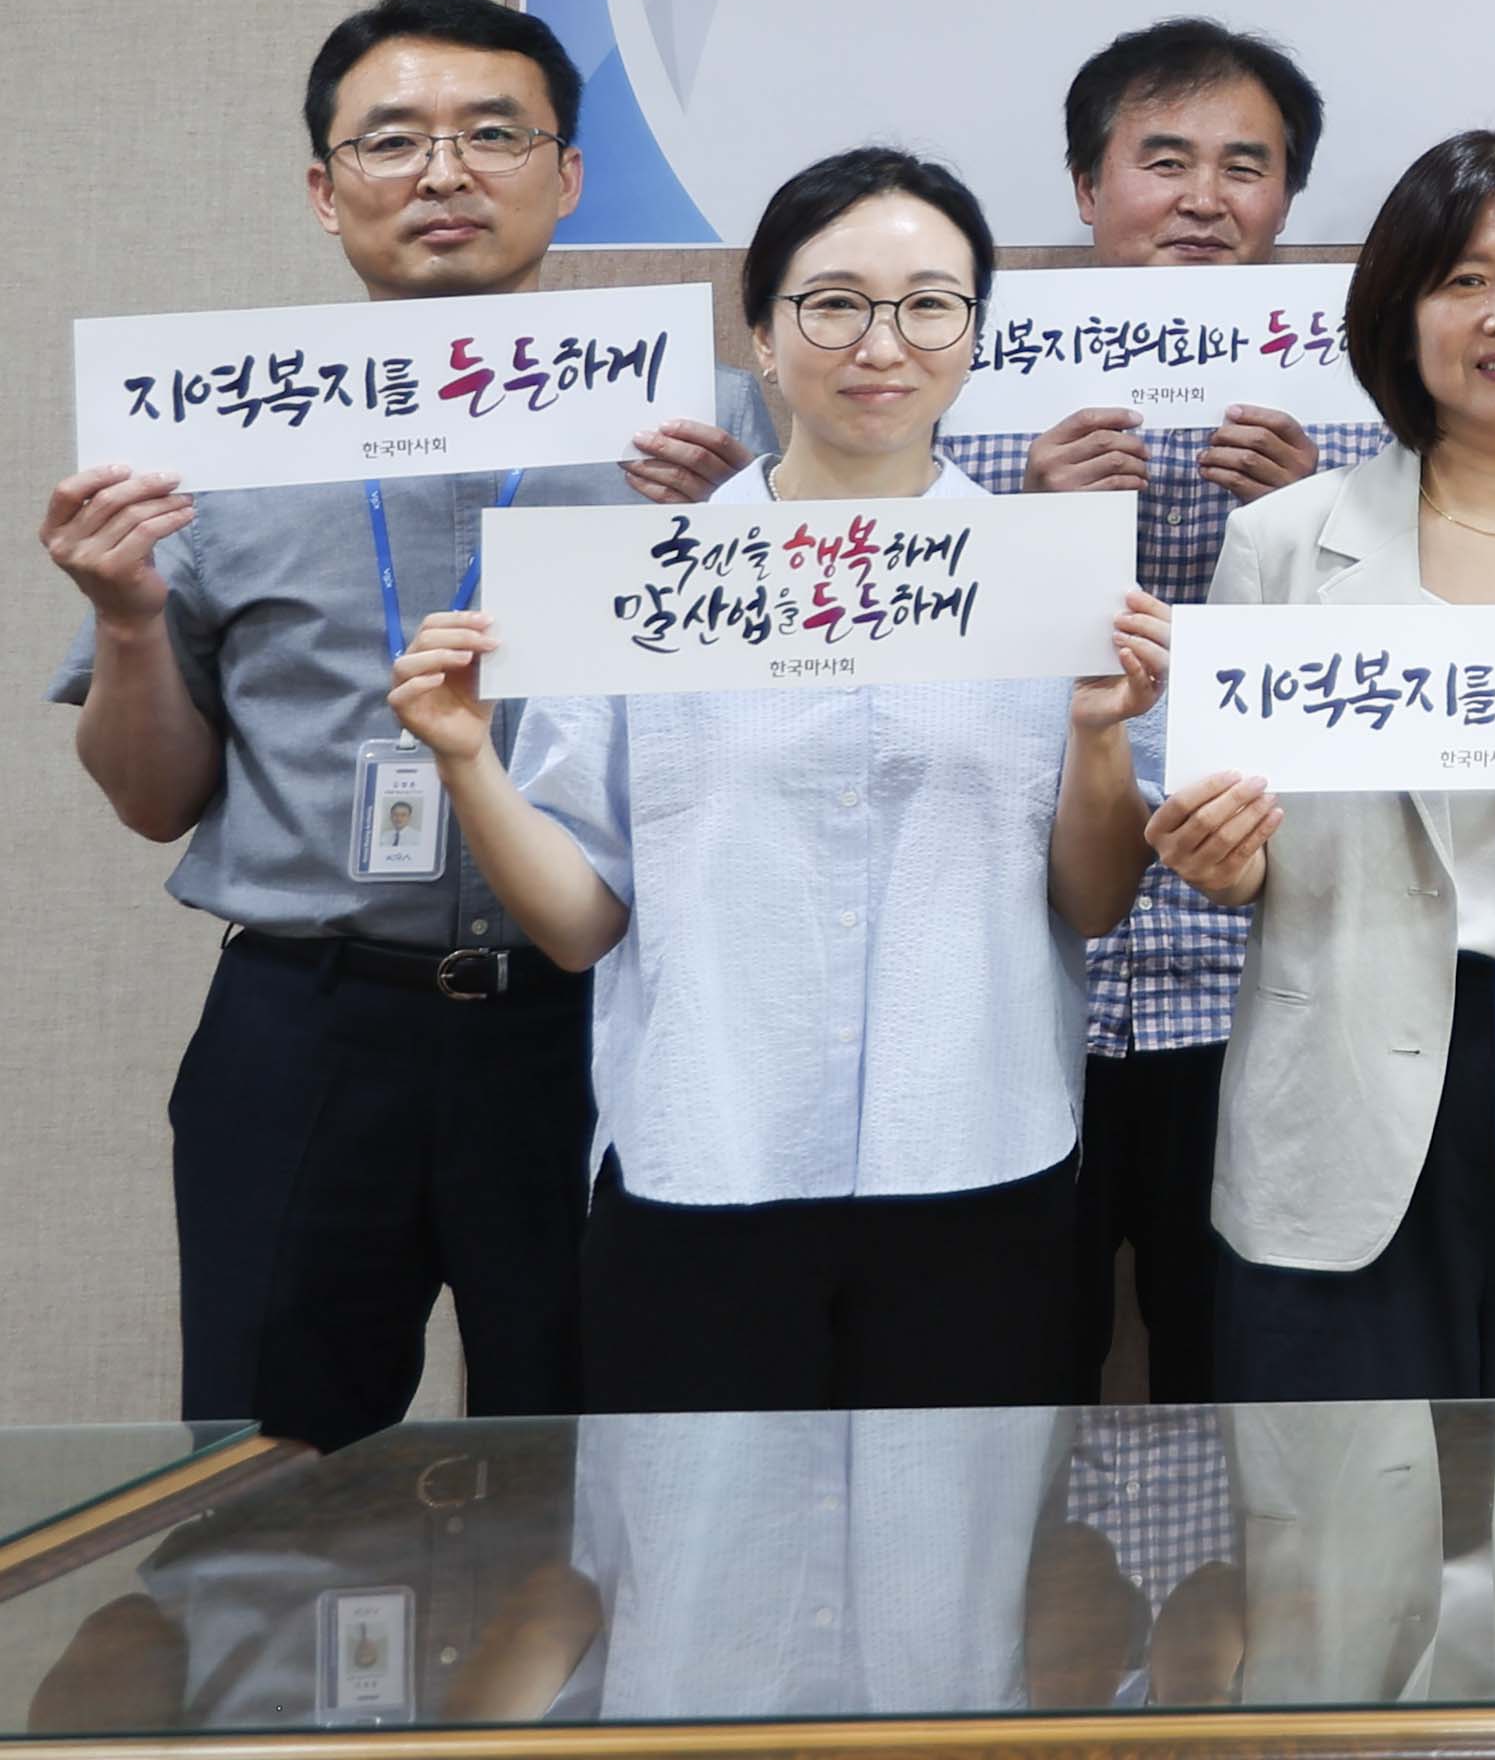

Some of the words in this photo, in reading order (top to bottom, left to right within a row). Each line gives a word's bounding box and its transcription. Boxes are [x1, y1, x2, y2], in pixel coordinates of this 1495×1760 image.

[124, 350, 419, 428] 지역복지를
[438, 331, 667, 418] 든든하게
[1129, 387, 1205, 405] 한국마사회
[363, 438, 446, 458] 한국마사회
[650, 515, 771, 593] 국민을
[782, 515, 971, 585] 행복하게
[802, 581, 978, 645] 든든하게
[771, 658, 854, 677] 한국마사회
